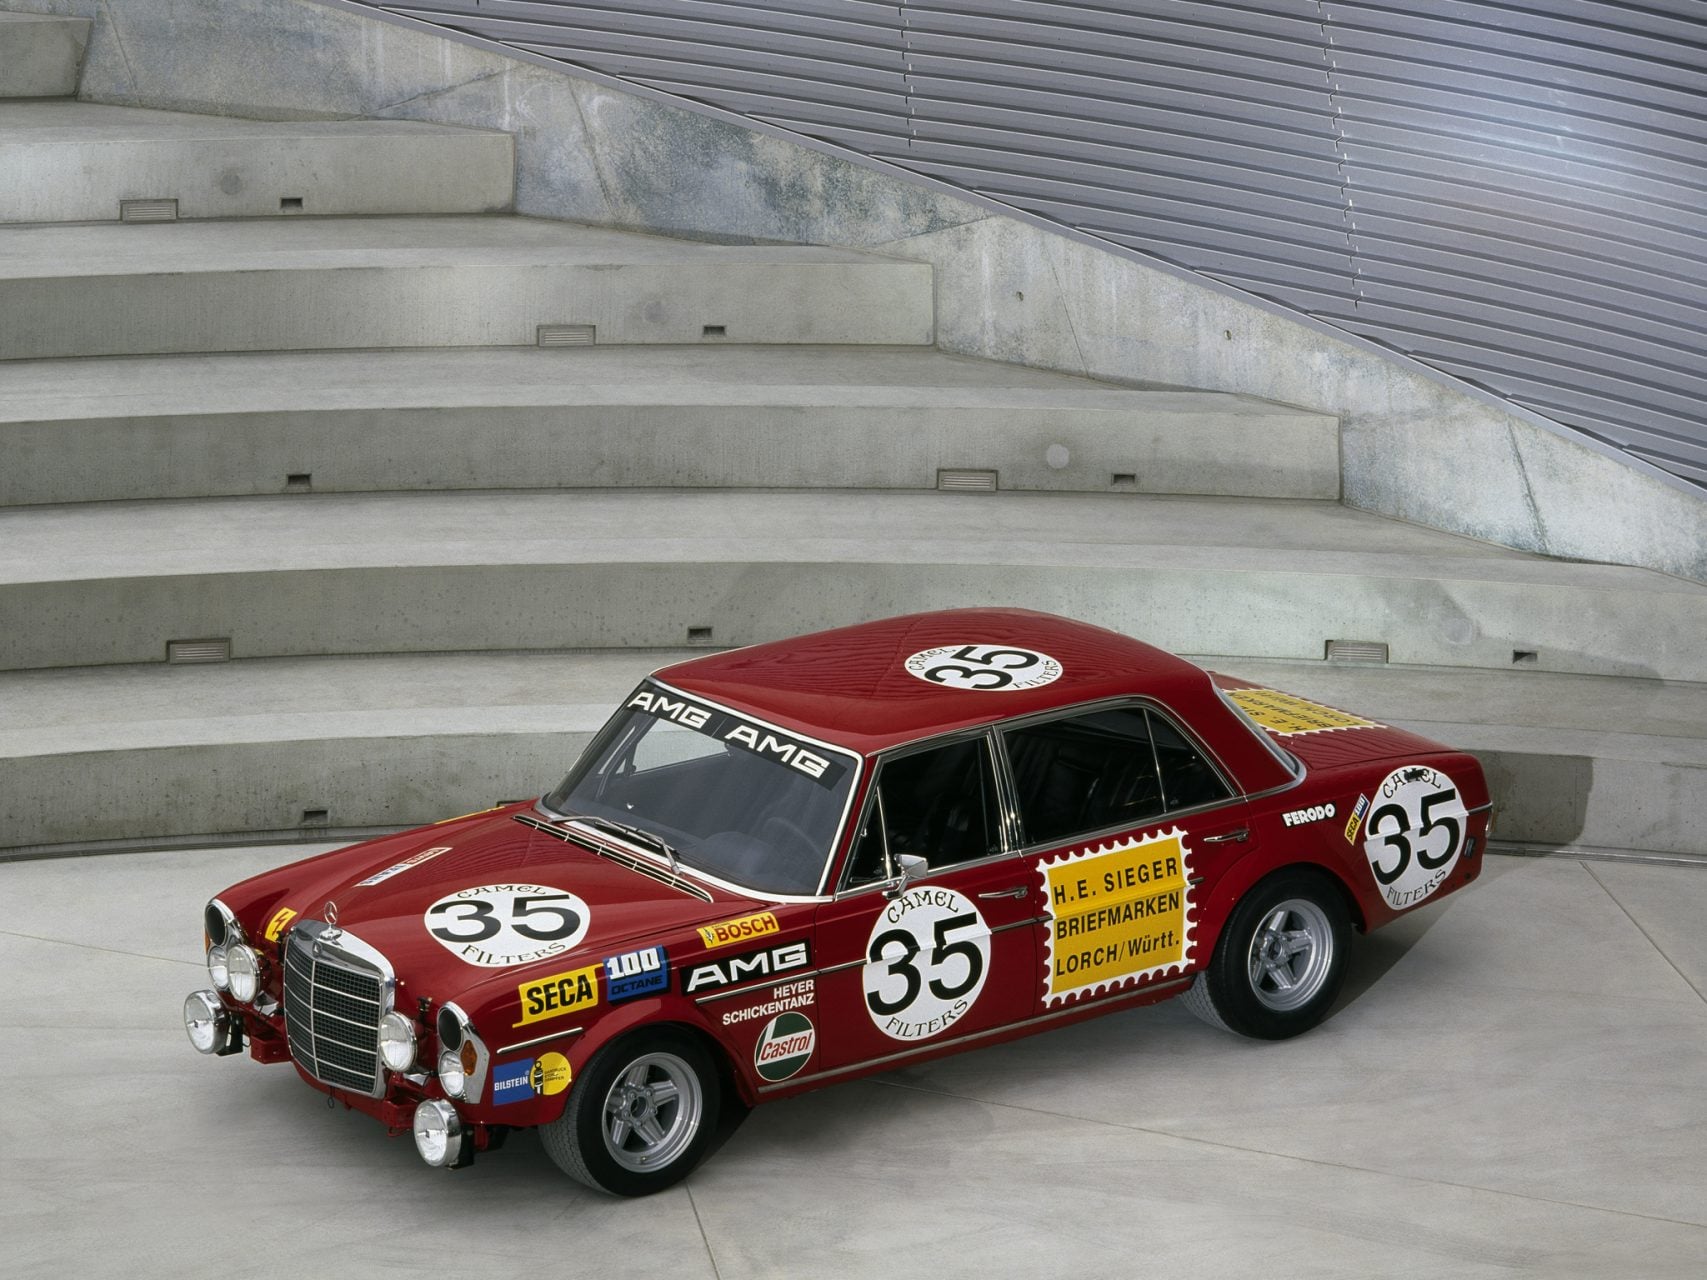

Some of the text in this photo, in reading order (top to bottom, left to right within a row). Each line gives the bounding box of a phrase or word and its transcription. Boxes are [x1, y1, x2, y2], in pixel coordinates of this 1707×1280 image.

[909, 648, 956, 671] CAMEL
[924, 645, 1039, 689] 35
[1013, 660, 1059, 689] FILTERS
[626, 691, 830, 779] AMG AMG
[1283, 803, 1336, 827] FERODO
[1368, 787, 1460, 886] 35
[457, 884, 546, 899] CAMEL
[1103, 857, 1178, 893] SIEGER
[1386, 868, 1447, 906] FILTERS
[429, 894, 581, 943] 35
[887, 890, 960, 924] CAMEL
[1056, 891, 1180, 940] BRIEFMARKEN
[714, 915, 776, 942] BOSCH
[461, 942, 566, 965] FILTERS
[606, 947, 661, 980] 100
[687, 943, 808, 992] AMG
[867, 911, 983, 1016] 35
[1056, 930, 1180, 977] LORCH/Württ.
[526, 974, 593, 1016] SECA
[611, 974, 663, 996] OCTANE
[773, 979, 815, 999] HEYER
[722, 992, 815, 1026] SCHICKENTANZ
[885, 999, 968, 1038] FILTERS
[760, 1031, 813, 1062] Castrol
[494, 1075, 529, 1091] BILSTEIN
